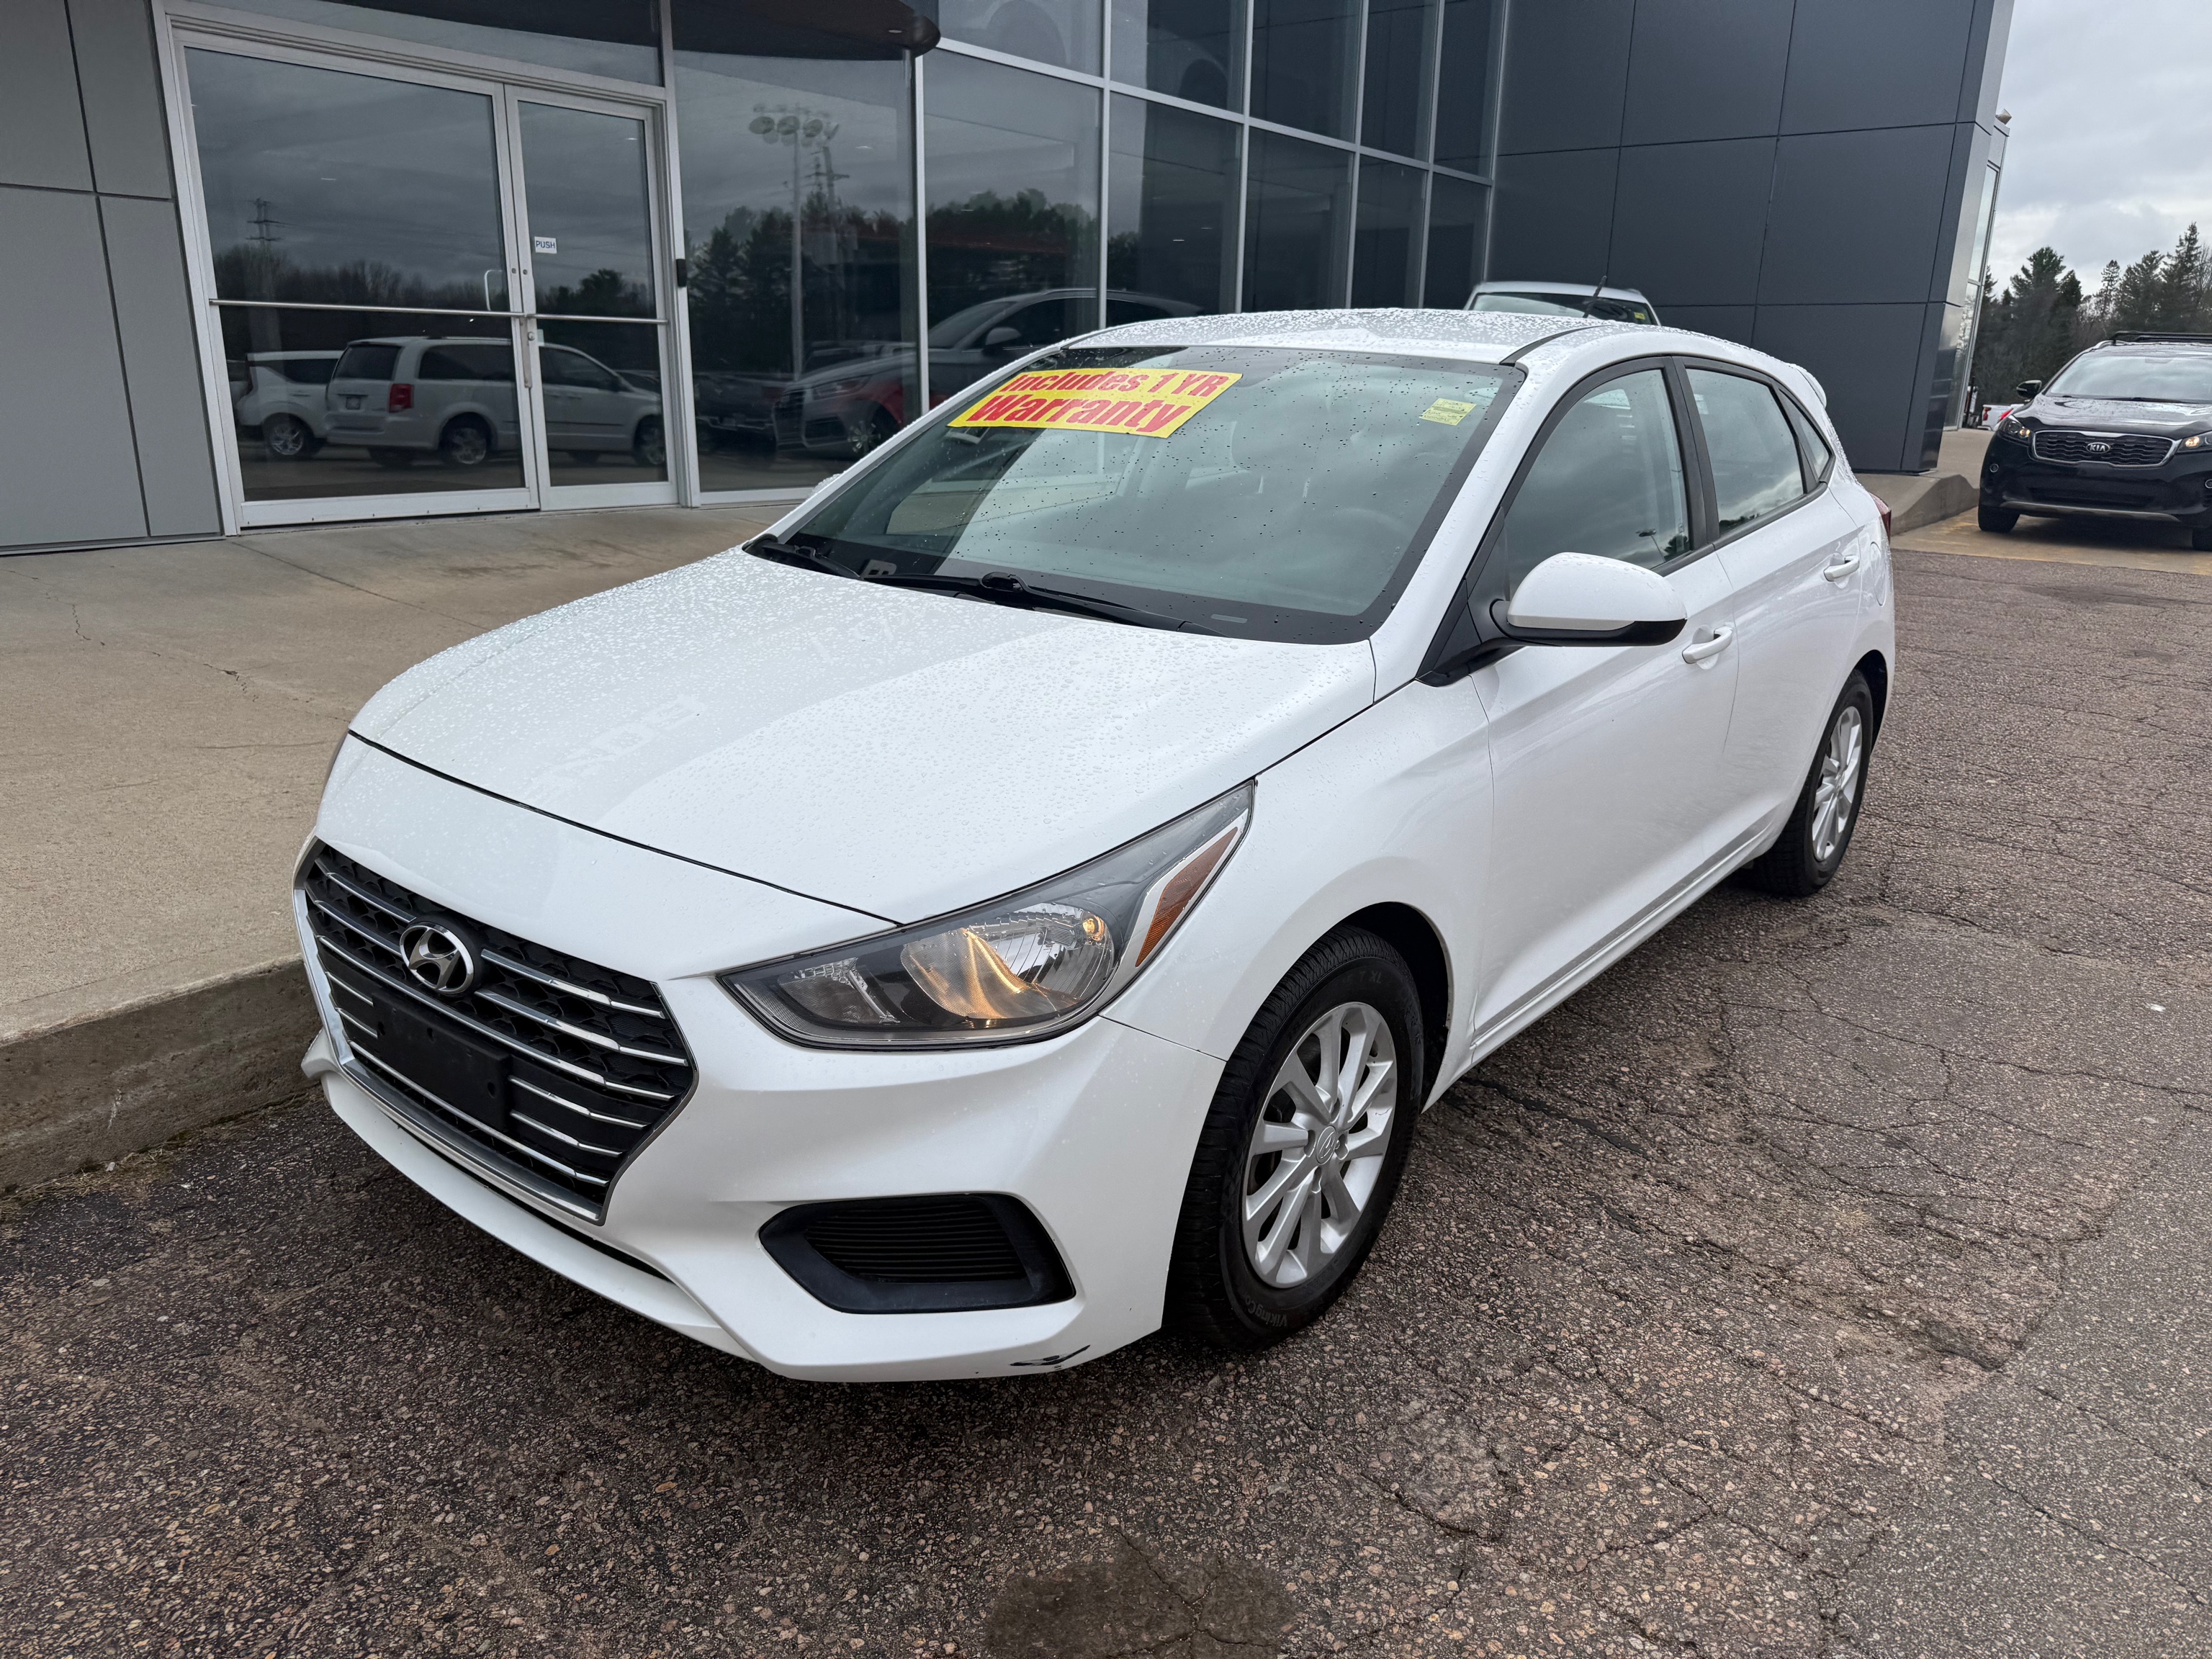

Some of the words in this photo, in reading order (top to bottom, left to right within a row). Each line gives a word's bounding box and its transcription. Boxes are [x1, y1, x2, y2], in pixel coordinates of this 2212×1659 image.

[1002, 372, 1148, 392] Includes
[1148, 372, 1178, 393] 1
[1172, 374, 1229, 397] YR
[966, 394, 1192, 433] Warranty
